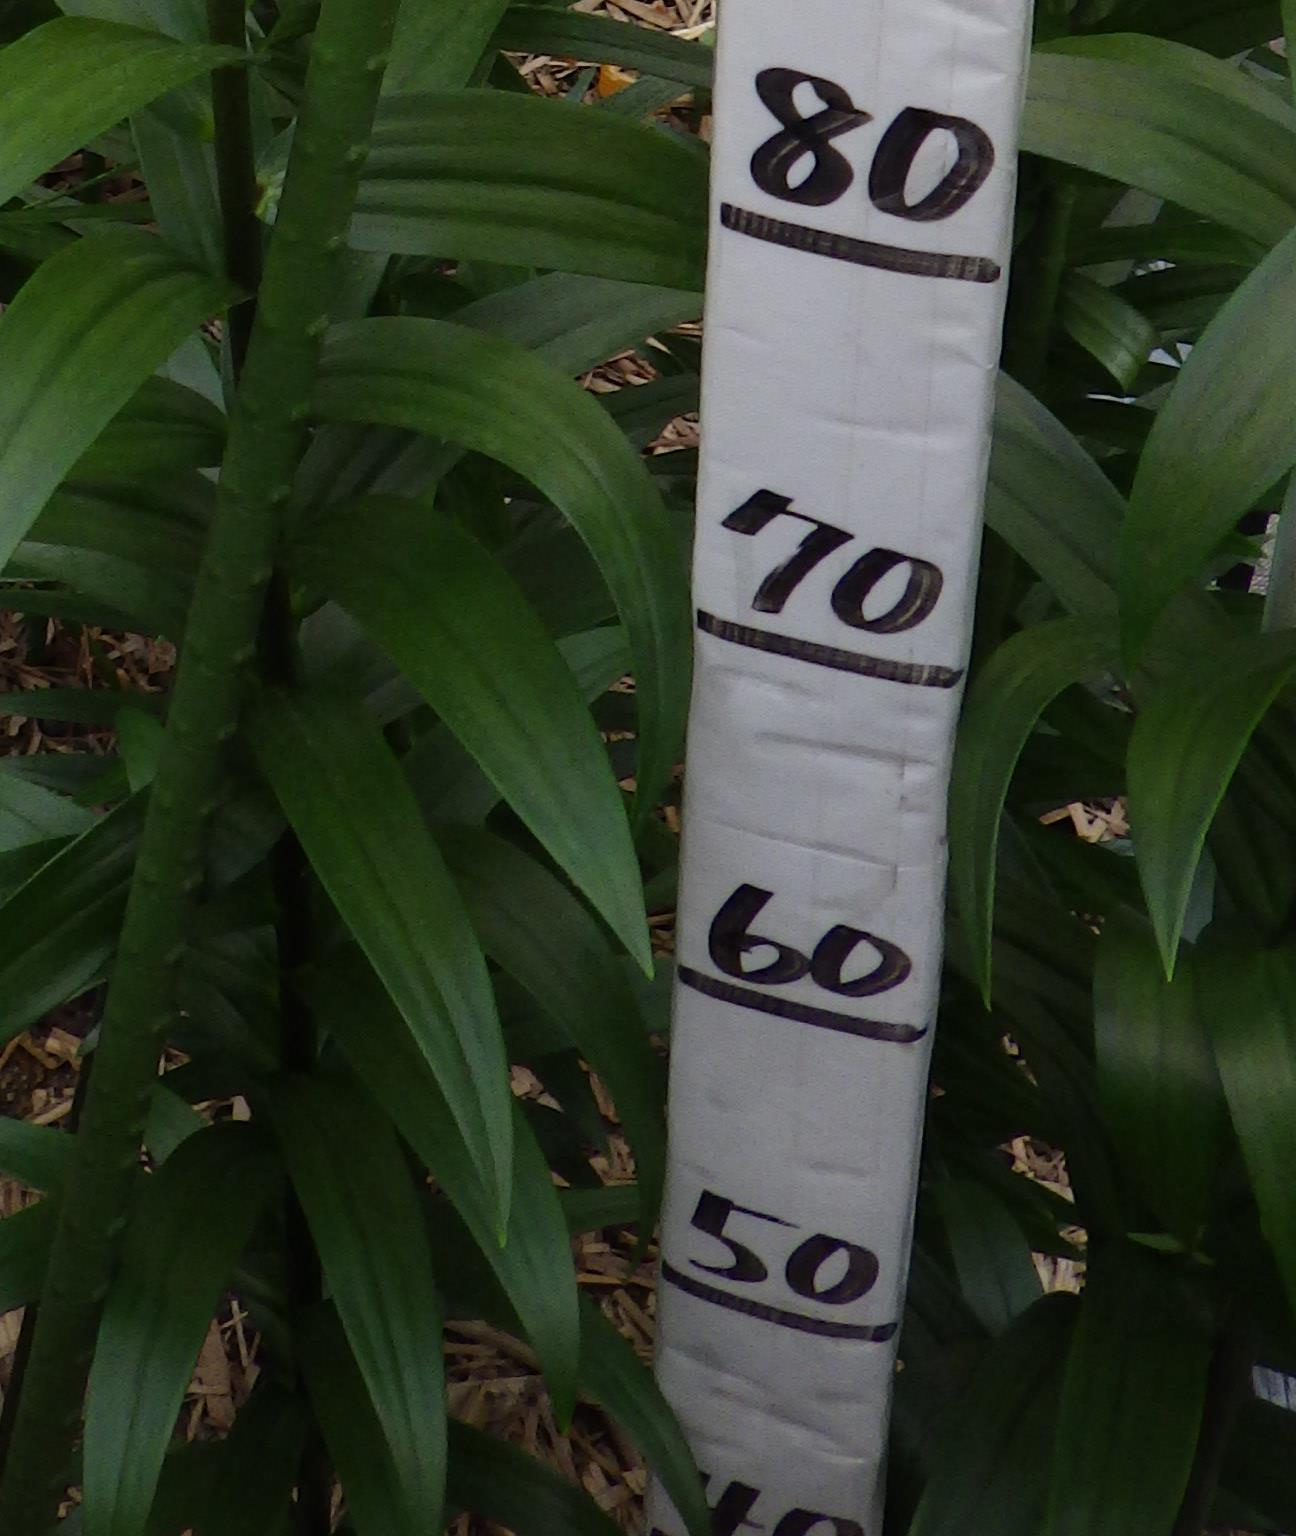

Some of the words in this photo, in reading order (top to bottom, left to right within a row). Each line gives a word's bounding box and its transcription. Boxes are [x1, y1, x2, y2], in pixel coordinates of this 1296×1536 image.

[750, 67, 995, 222] 80
[721, 489, 943, 634] 70
[708, 883, 912, 997] 60
[688, 1188, 879, 1304] 50
